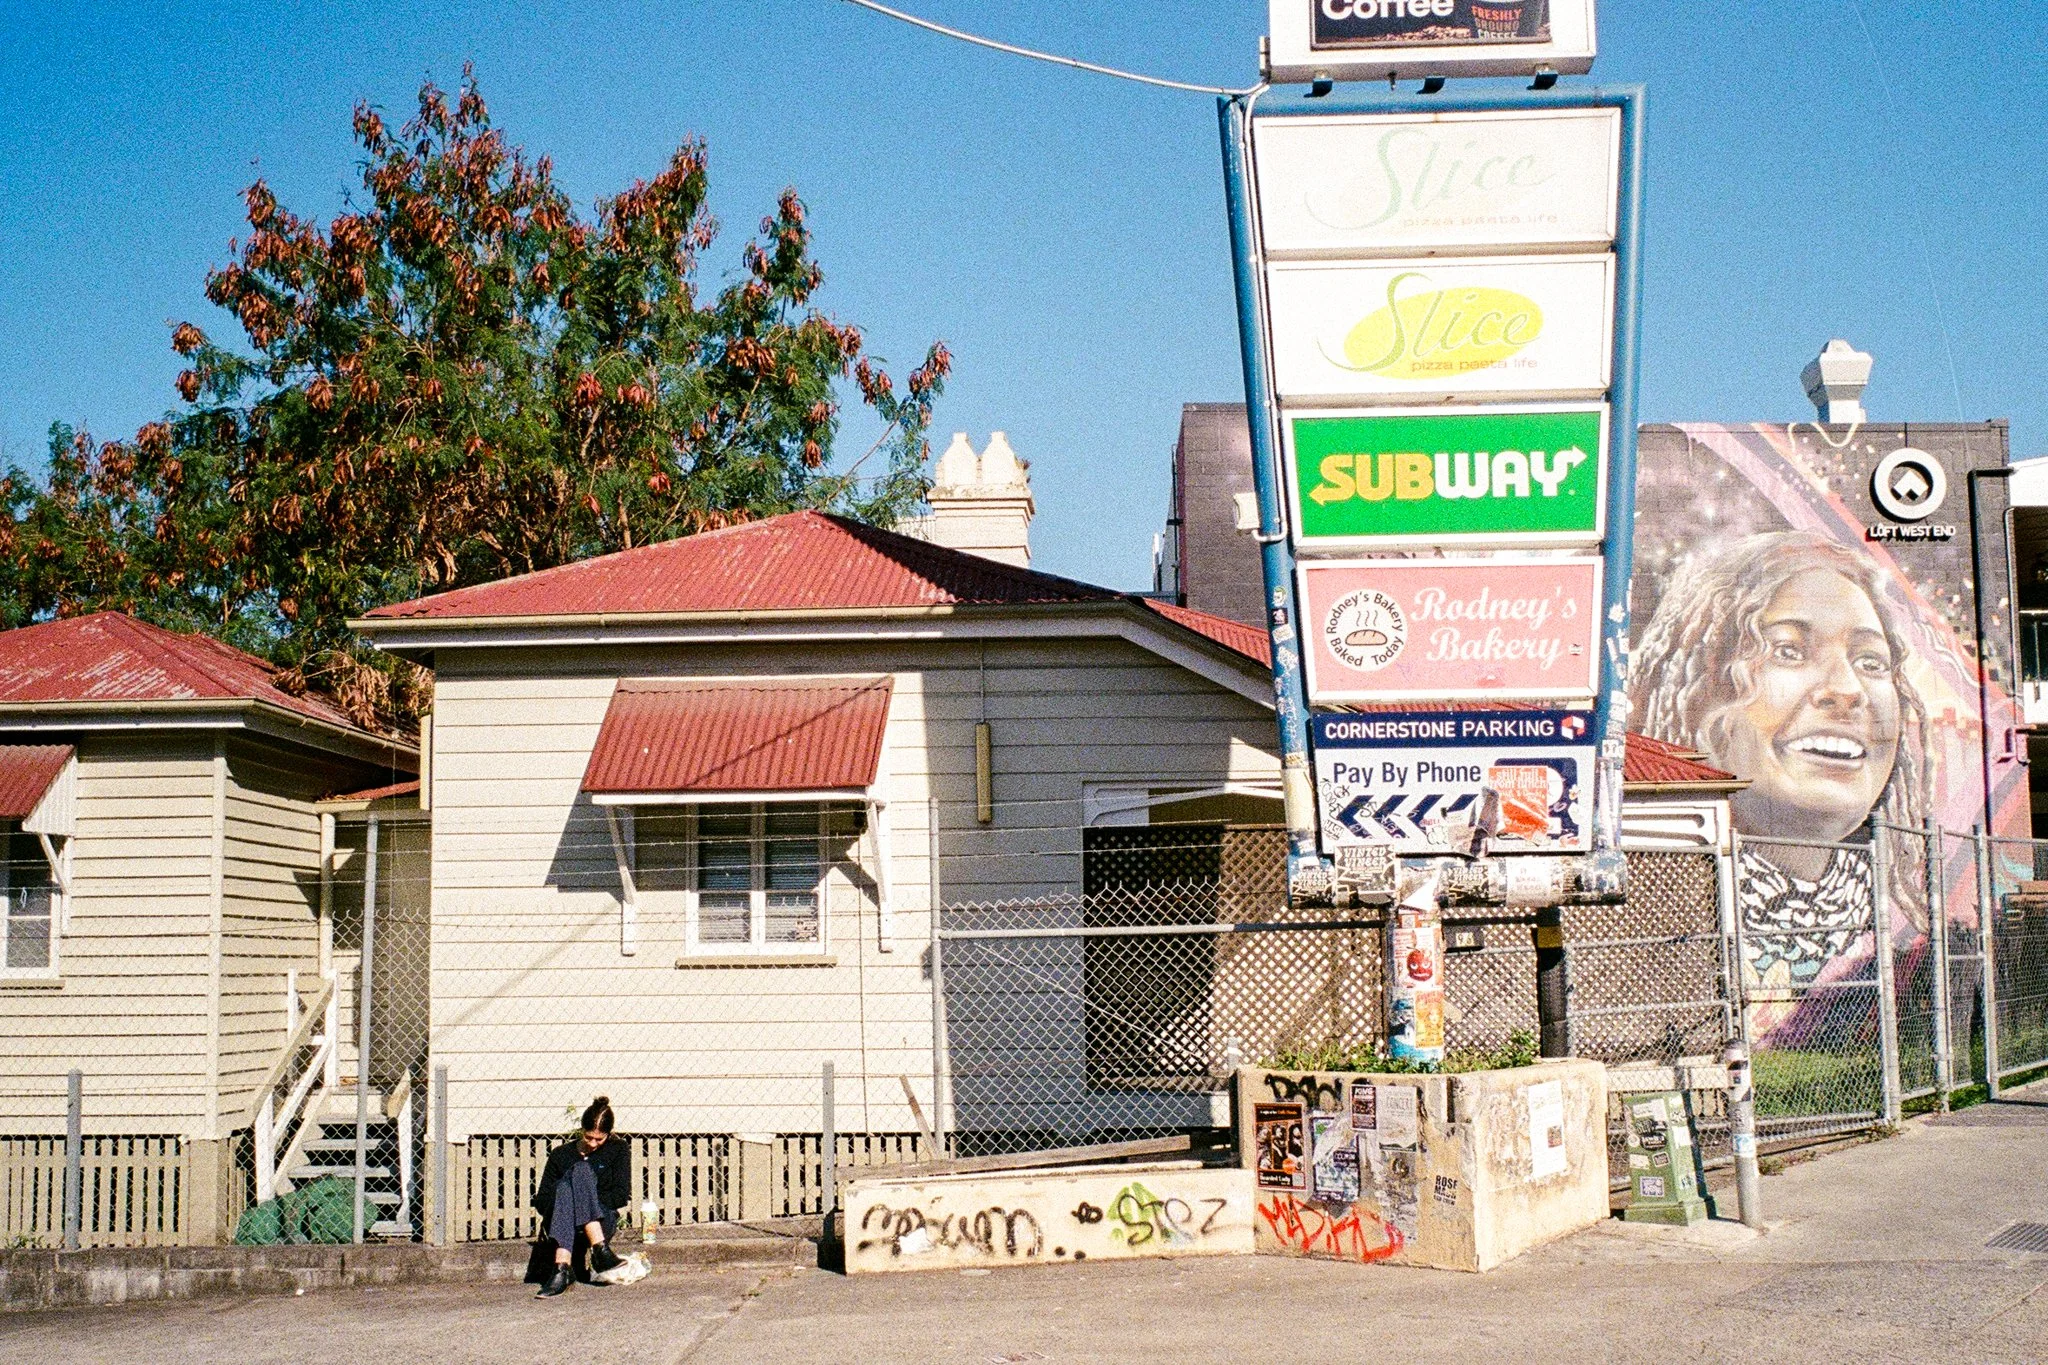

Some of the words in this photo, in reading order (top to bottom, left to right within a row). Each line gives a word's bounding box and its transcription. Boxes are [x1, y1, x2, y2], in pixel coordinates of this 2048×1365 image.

[1321, 0, 1454, 20] Coffee
[1471, 5, 1522, 21] FRESHLY
[1304, 127, 1558, 231] Slice
[1316, 272, 1541, 372] Slice
[1411, 360, 1453, 372] pizza
[1514, 357, 1538, 368] life
[1309, 446, 1588, 506] SUBWAY
[1900, 525, 1931, 537] WEST
[1933, 525, 1957, 537] END
[1326, 591, 1370, 634] Rodney's
[1373, 592, 1404, 632] Bakery
[1410, 586, 1577, 631] Rodney's
[1330, 637, 1364, 667] Baked
[1371, 635, 1404, 666] Today
[1426, 626, 1565, 671] Bakery
[1325, 721, 1456, 740] CORNERSTONE
[1462, 719, 1555, 737] PARKING
[1333, 762, 1374, 788] Pay
[1382, 762, 1408, 787] By
[1417, 761, 1482, 783] Phone
